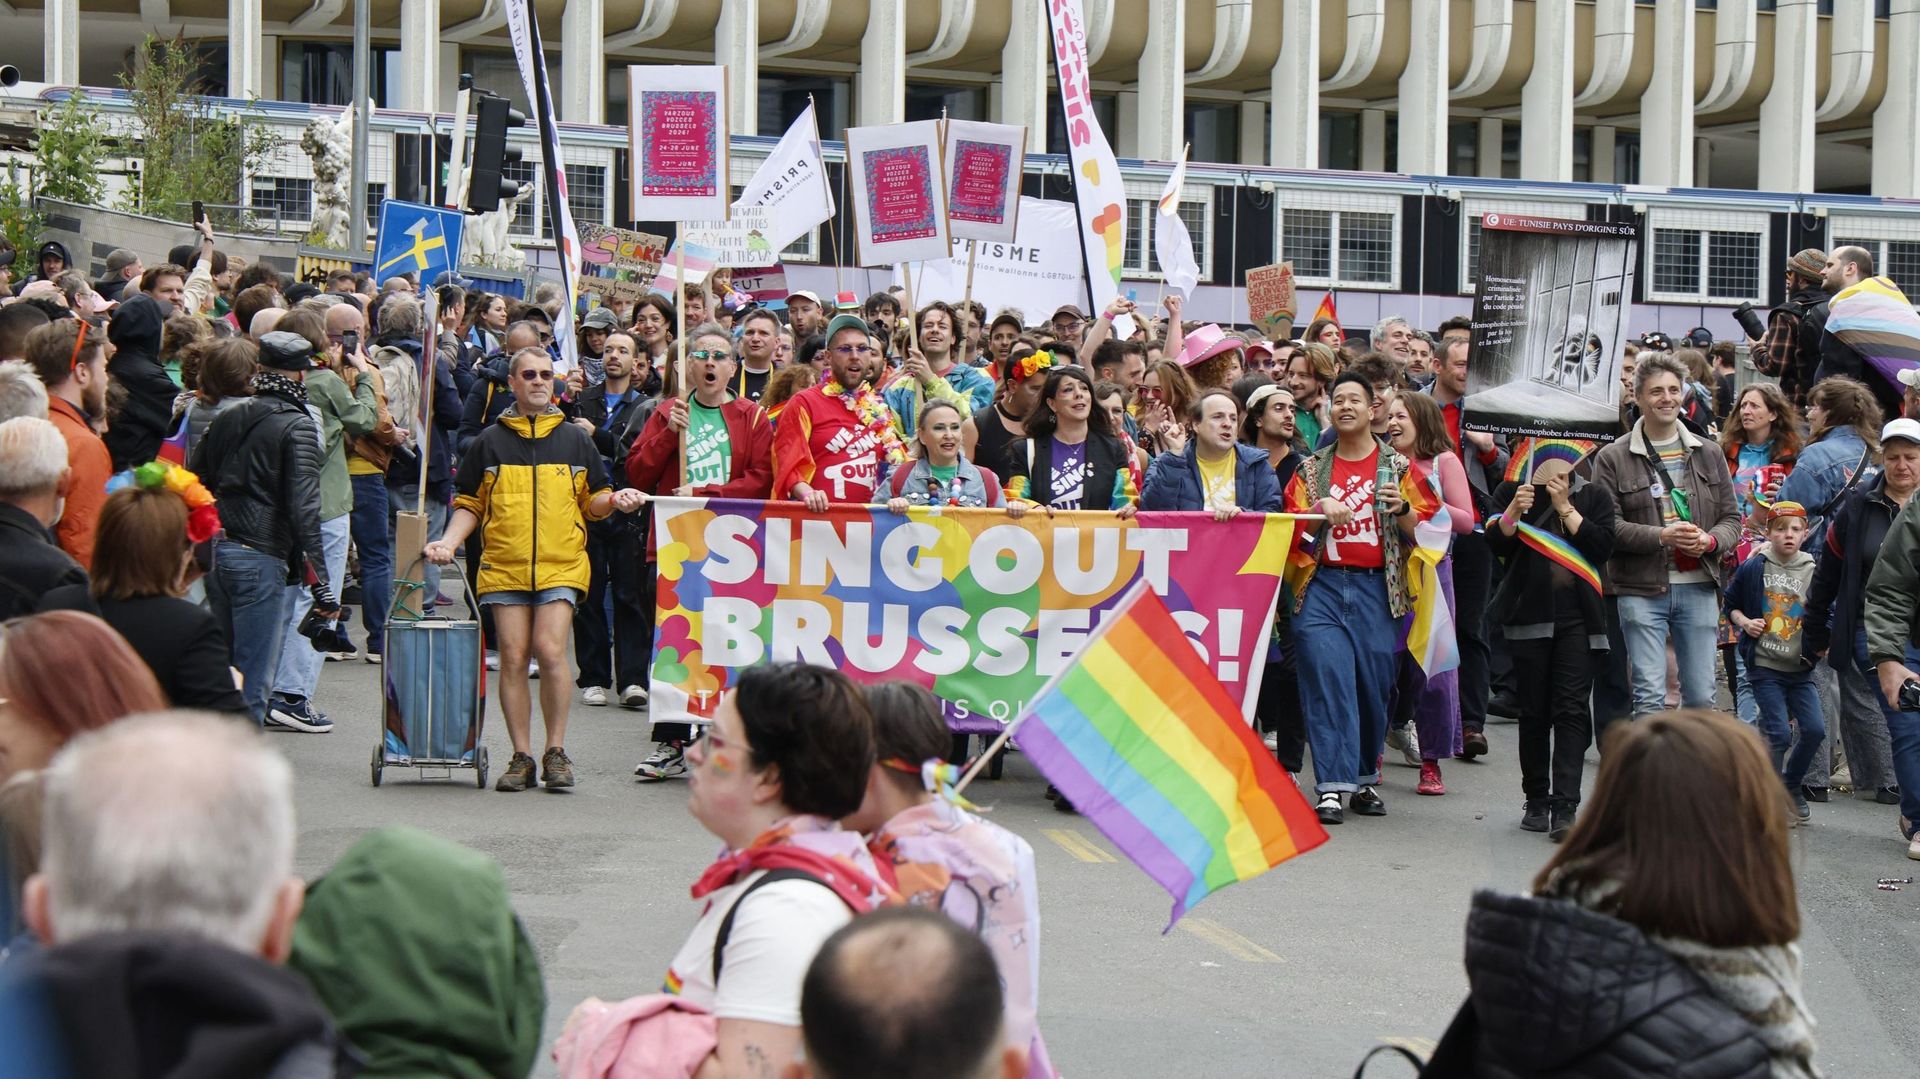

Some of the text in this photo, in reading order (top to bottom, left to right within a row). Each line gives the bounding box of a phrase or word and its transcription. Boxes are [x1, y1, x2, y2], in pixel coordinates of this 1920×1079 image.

[1503, 218, 1636, 236] UE: TUNISIE PAYS D'ORIGINE SÛR
[687, 429, 729, 461] SING
[825, 427, 854, 454] WE
[1465, 422, 1615, 441] Quand les pays homophobes deviennent sûrs
[1330, 484, 1346, 501] E
[1345, 480, 1376, 511] ING
[701, 515, 1188, 595] SING OUT
[702, 597, 1244, 682] BRUSSES!
